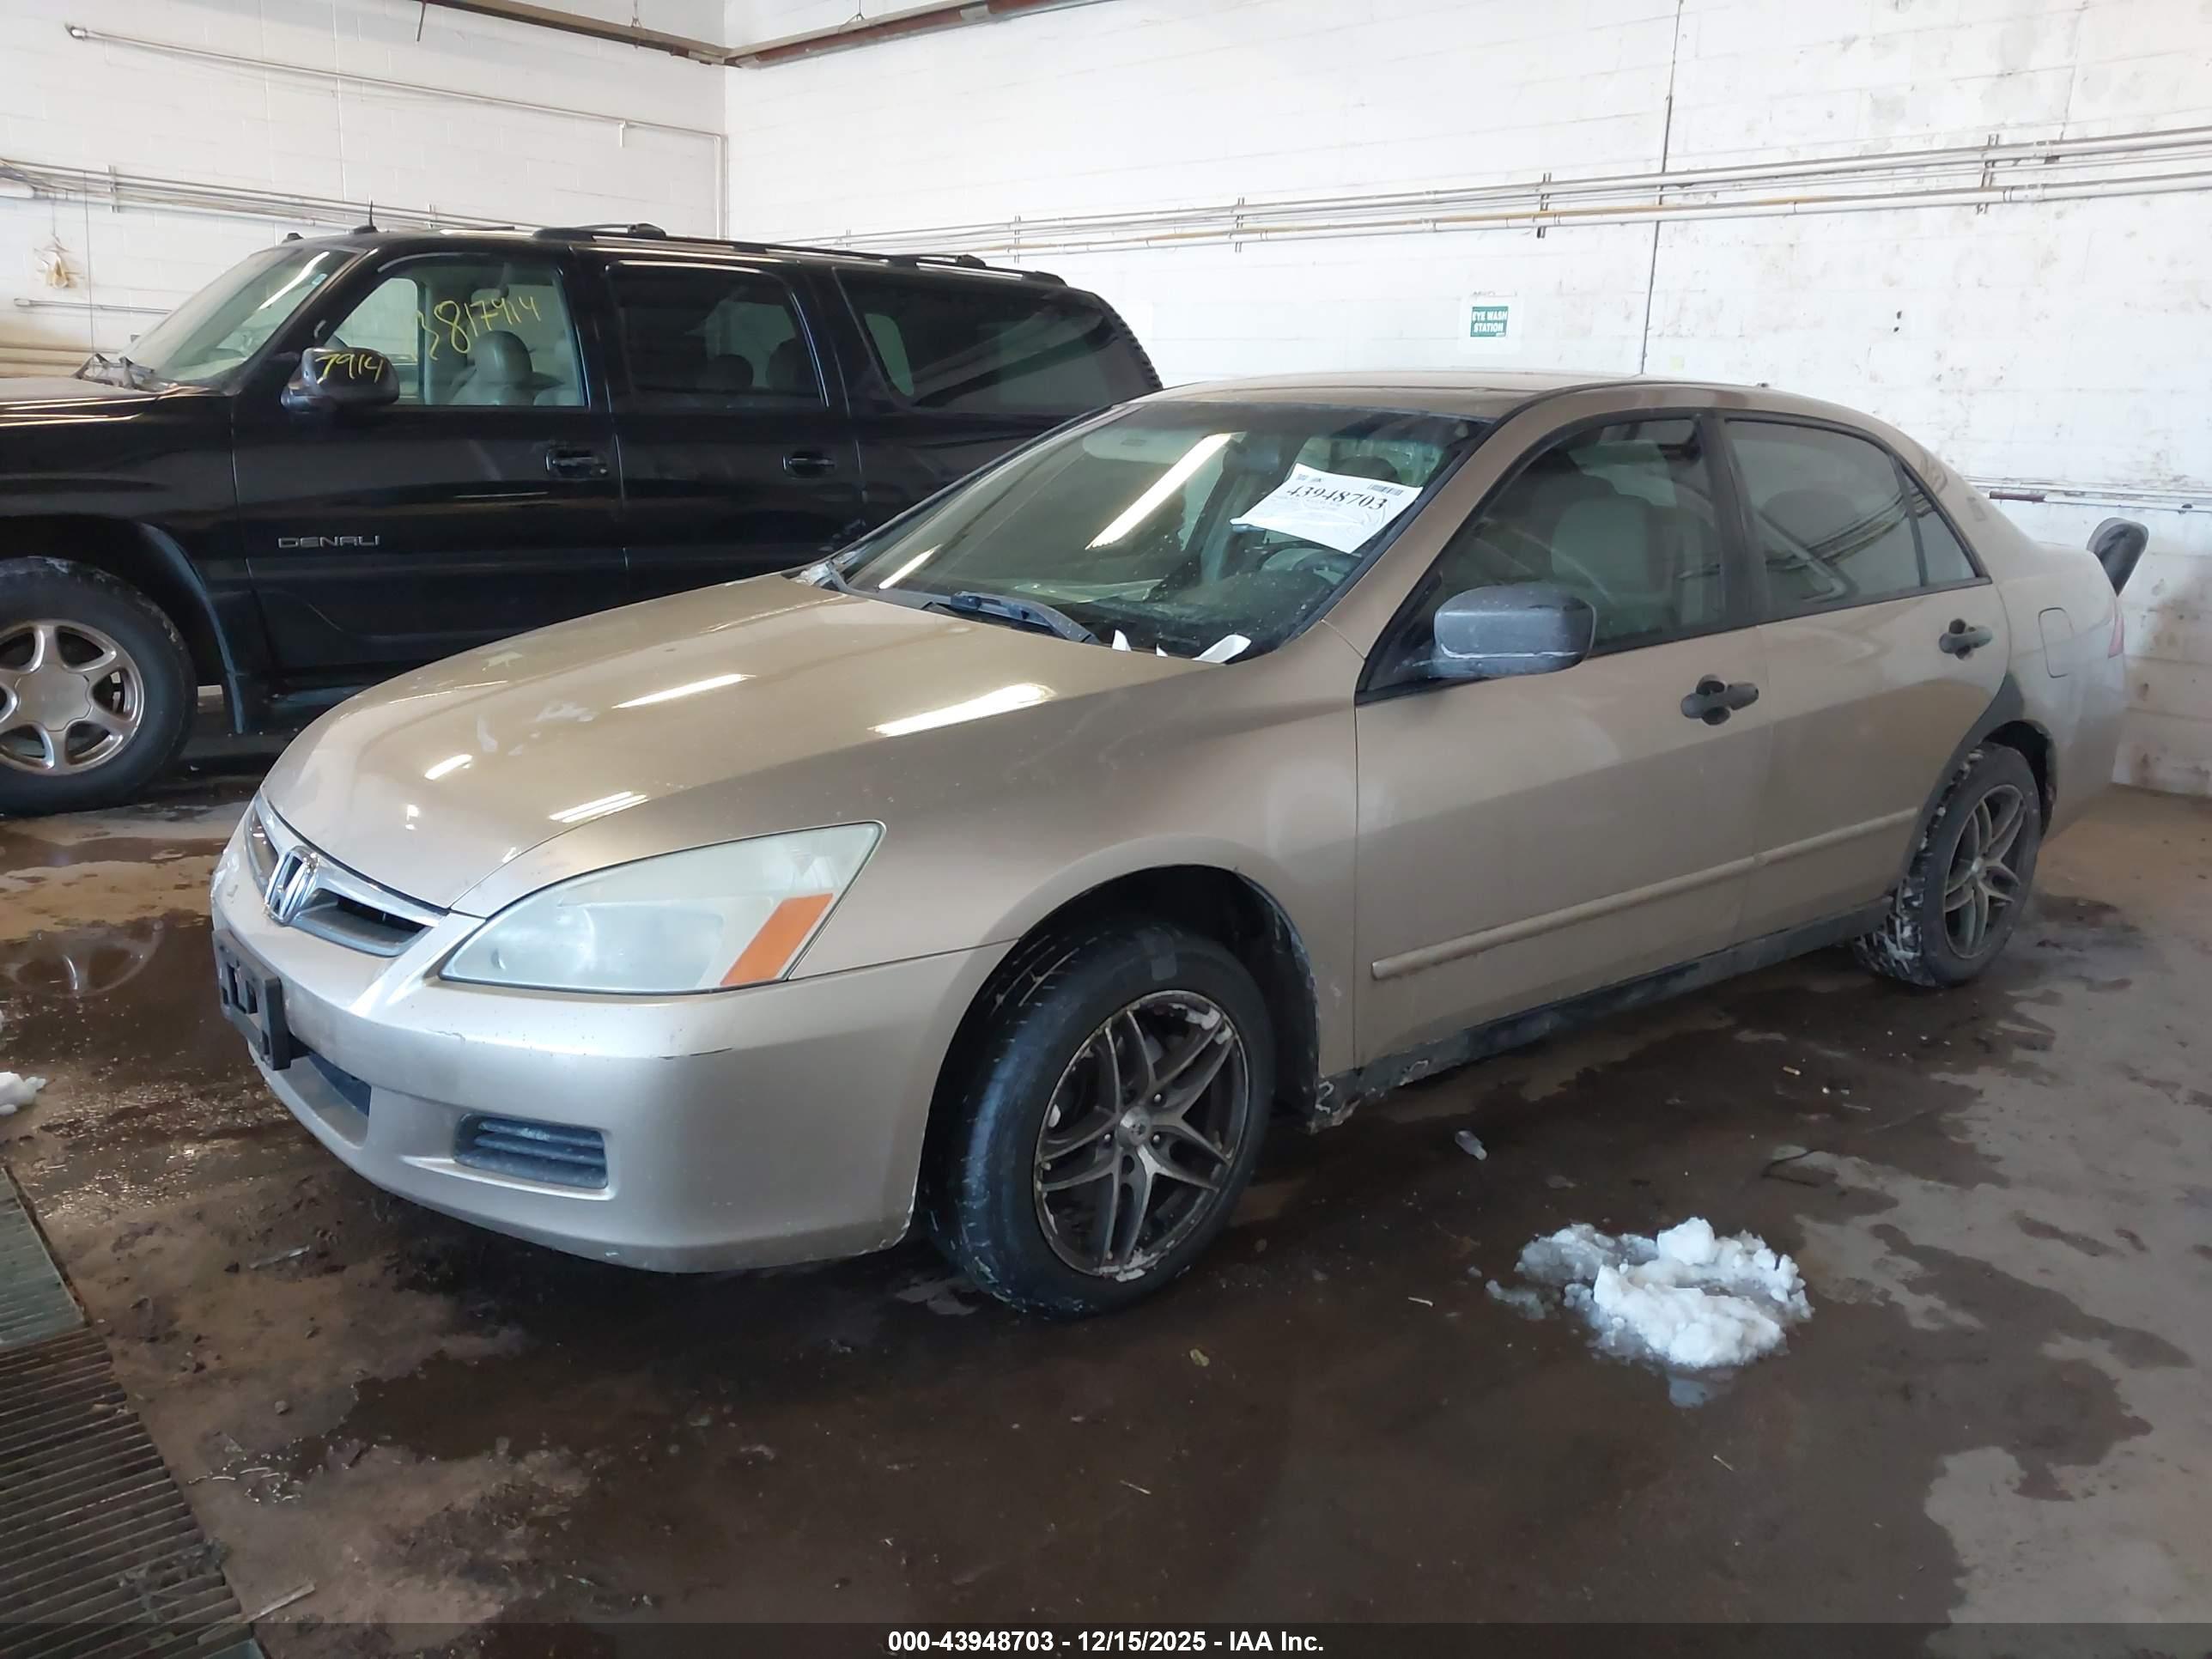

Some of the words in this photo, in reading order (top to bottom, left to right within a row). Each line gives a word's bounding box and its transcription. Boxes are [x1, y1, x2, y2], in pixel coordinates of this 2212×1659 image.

[1472, 311, 1486, 321] EYE
[1486, 310, 1508, 321] WASH
[1474, 322, 1504, 332] STATION
[314, 353, 384, 385] 7914
[1286, 484, 1389, 511] 43948703
[277, 535, 380, 548] DENALI
